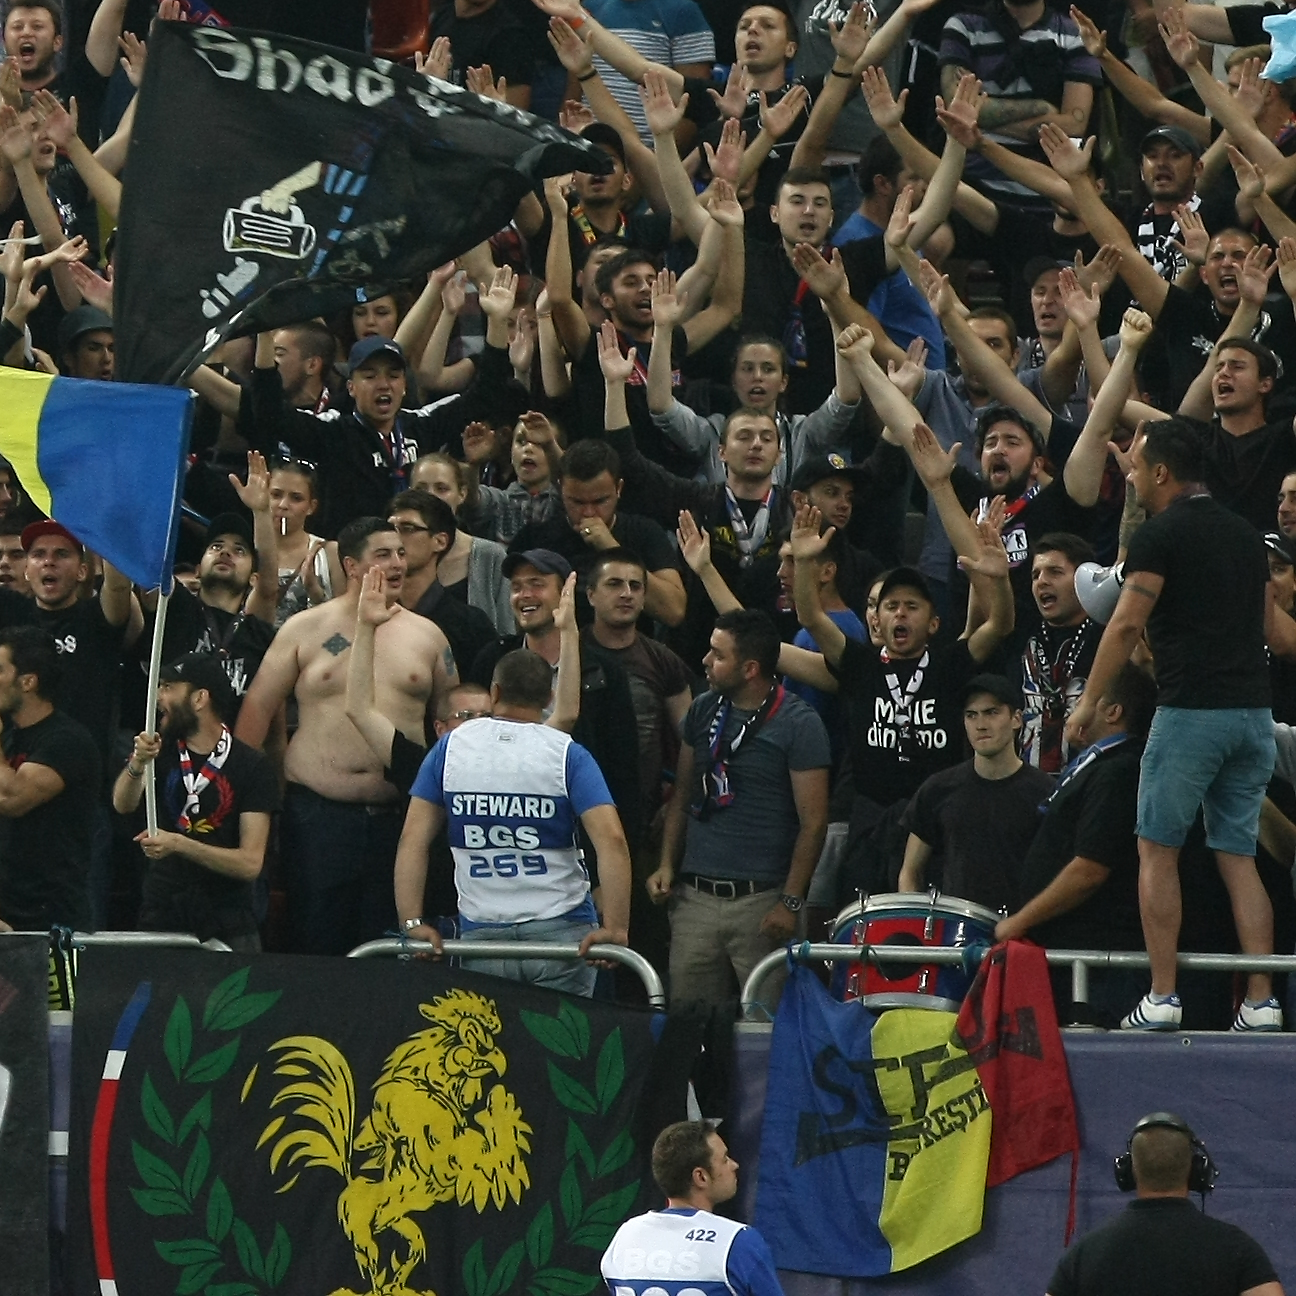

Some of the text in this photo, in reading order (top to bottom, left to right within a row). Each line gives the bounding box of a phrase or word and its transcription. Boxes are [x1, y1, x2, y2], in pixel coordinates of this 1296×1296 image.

[867, 721, 948, 750] dinmo
[451, 794, 566, 820] STEWARD
[463, 824, 541, 851] BGS
[469, 854, 549, 879] 259
[684, 1228, 717, 1245] 422
